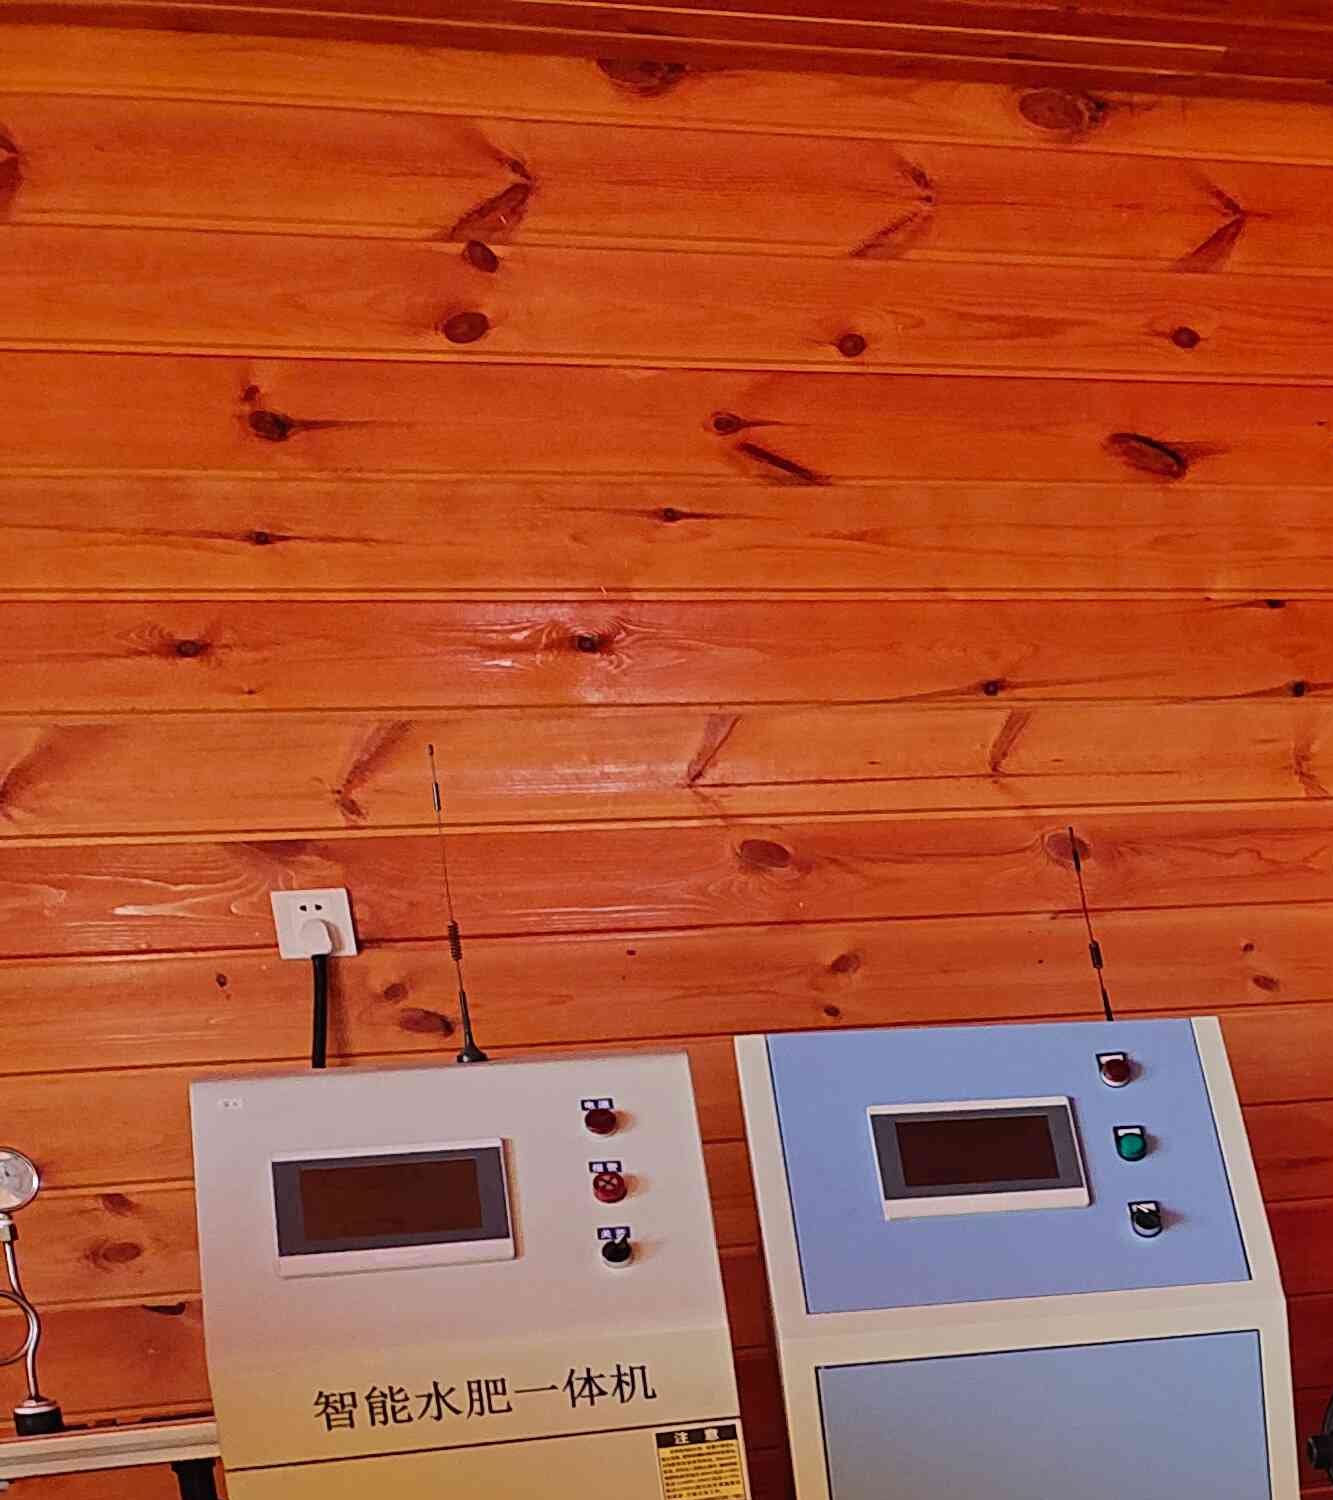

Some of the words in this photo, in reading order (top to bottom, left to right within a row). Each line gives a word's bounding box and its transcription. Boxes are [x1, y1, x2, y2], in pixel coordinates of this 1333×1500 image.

[313, 1364, 657, 1431] 智能水肥一体机
